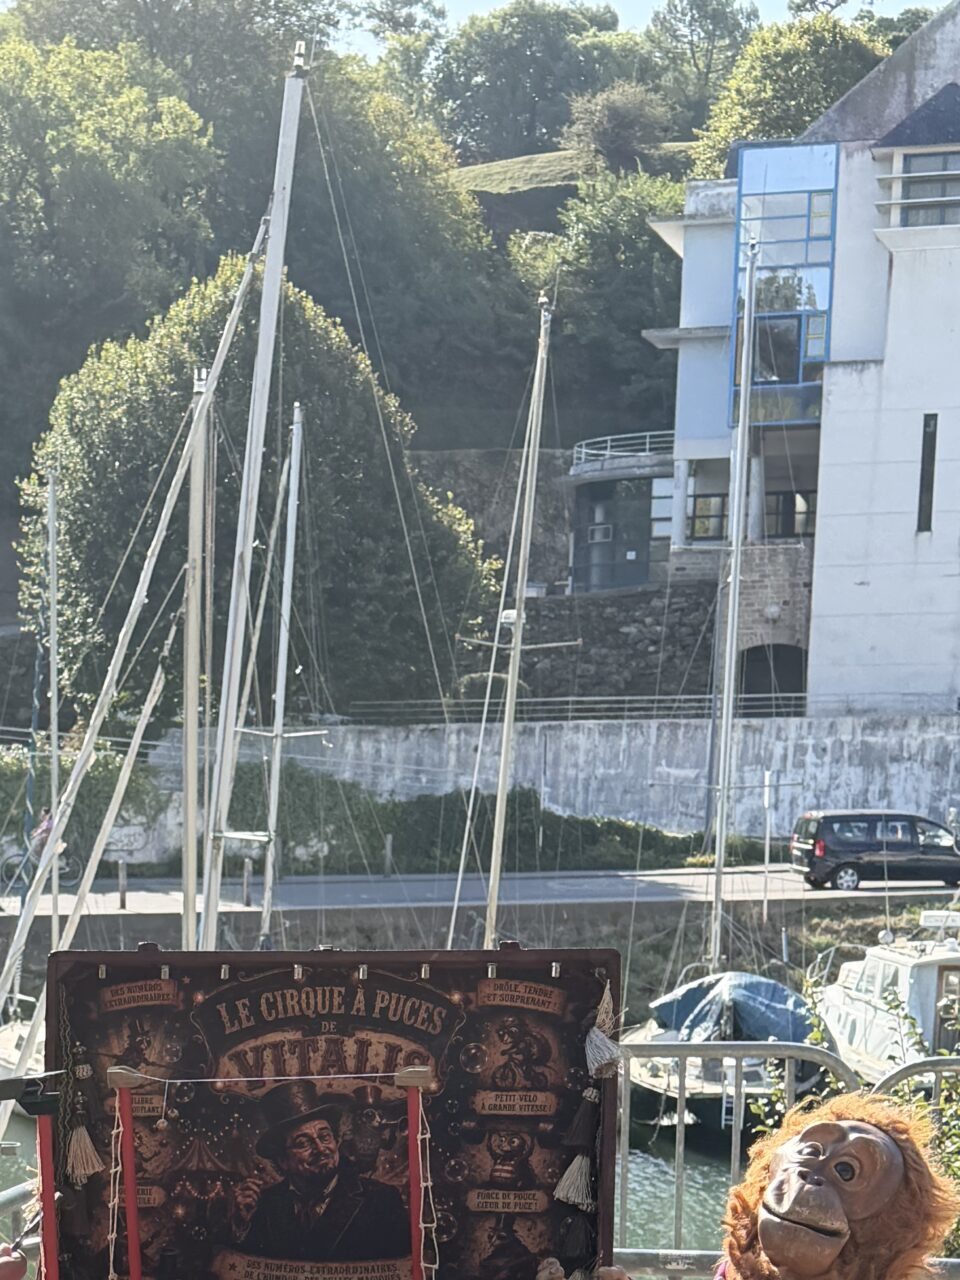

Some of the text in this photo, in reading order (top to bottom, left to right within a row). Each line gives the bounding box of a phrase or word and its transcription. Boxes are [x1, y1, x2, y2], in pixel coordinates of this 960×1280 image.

[523, 985, 554, 999] TENDRE
[499, 993, 552, 1009] SURPRENANT
[216, 984, 448, 1035] LE CIRQUE À PUCES
[320, 1020, 338, 1033] DE
[494, 1094, 516, 1103] PETIT
[488, 1103, 516, 1112] GRANDE
[519, 1103, 547, 1113] VITESSE
[477, 1191, 499, 1200] FORCE
[502, 1192, 511, 1200] DE
[502, 1201, 511, 1210] DE
[513, 1202, 532, 1210] PUCE
[246, 1259, 261, 1270] DES
[244, 1270, 254, 1280] DE
